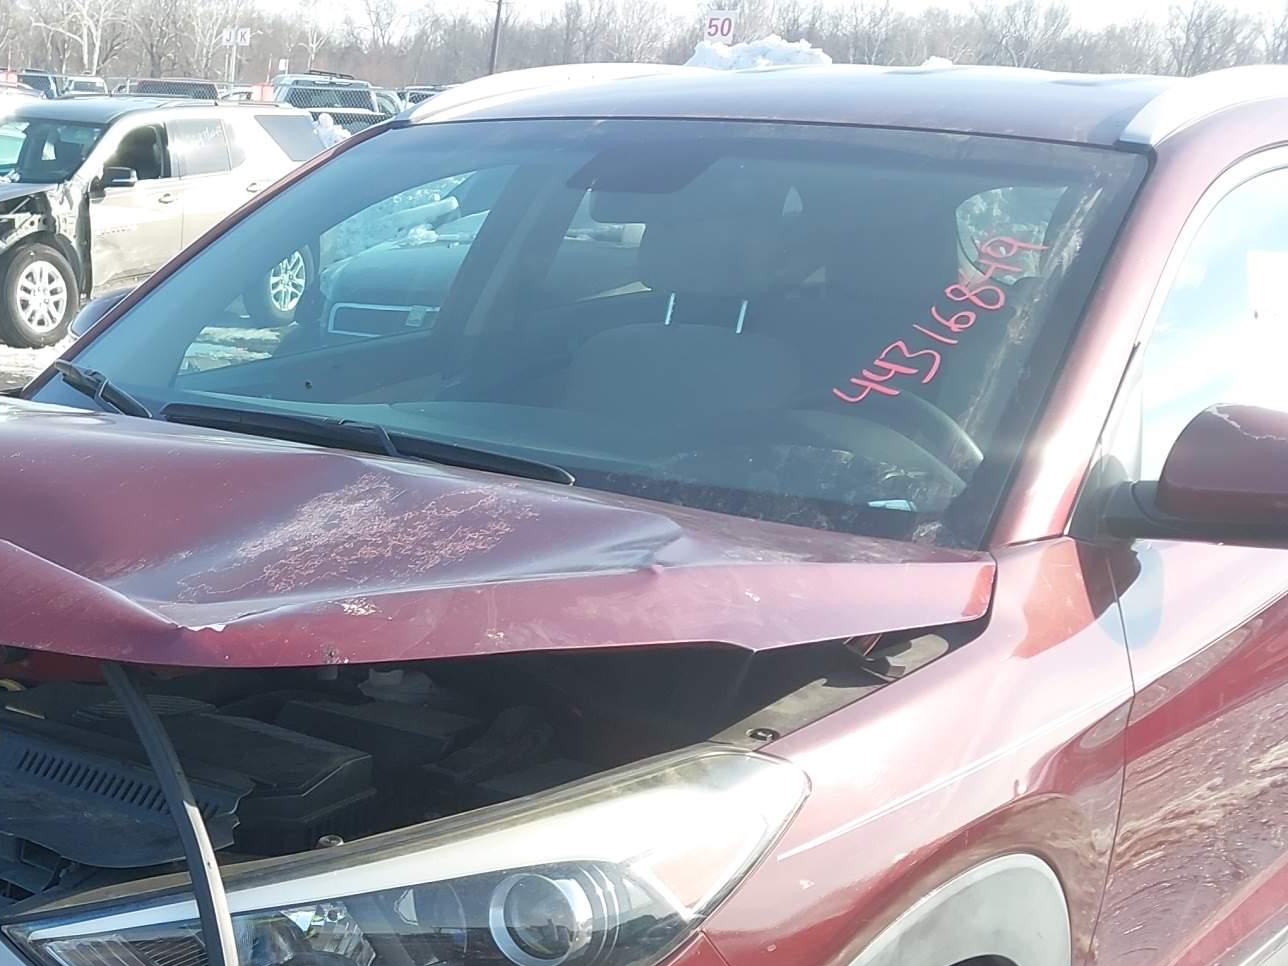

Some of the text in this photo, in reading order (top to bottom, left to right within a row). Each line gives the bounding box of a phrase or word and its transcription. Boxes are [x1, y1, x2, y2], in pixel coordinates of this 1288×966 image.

[707, 17, 732, 37] 50
[225, 31, 232, 42] J
[239, 31, 247, 42] K
[833, 236, 1049, 404] 44316849
